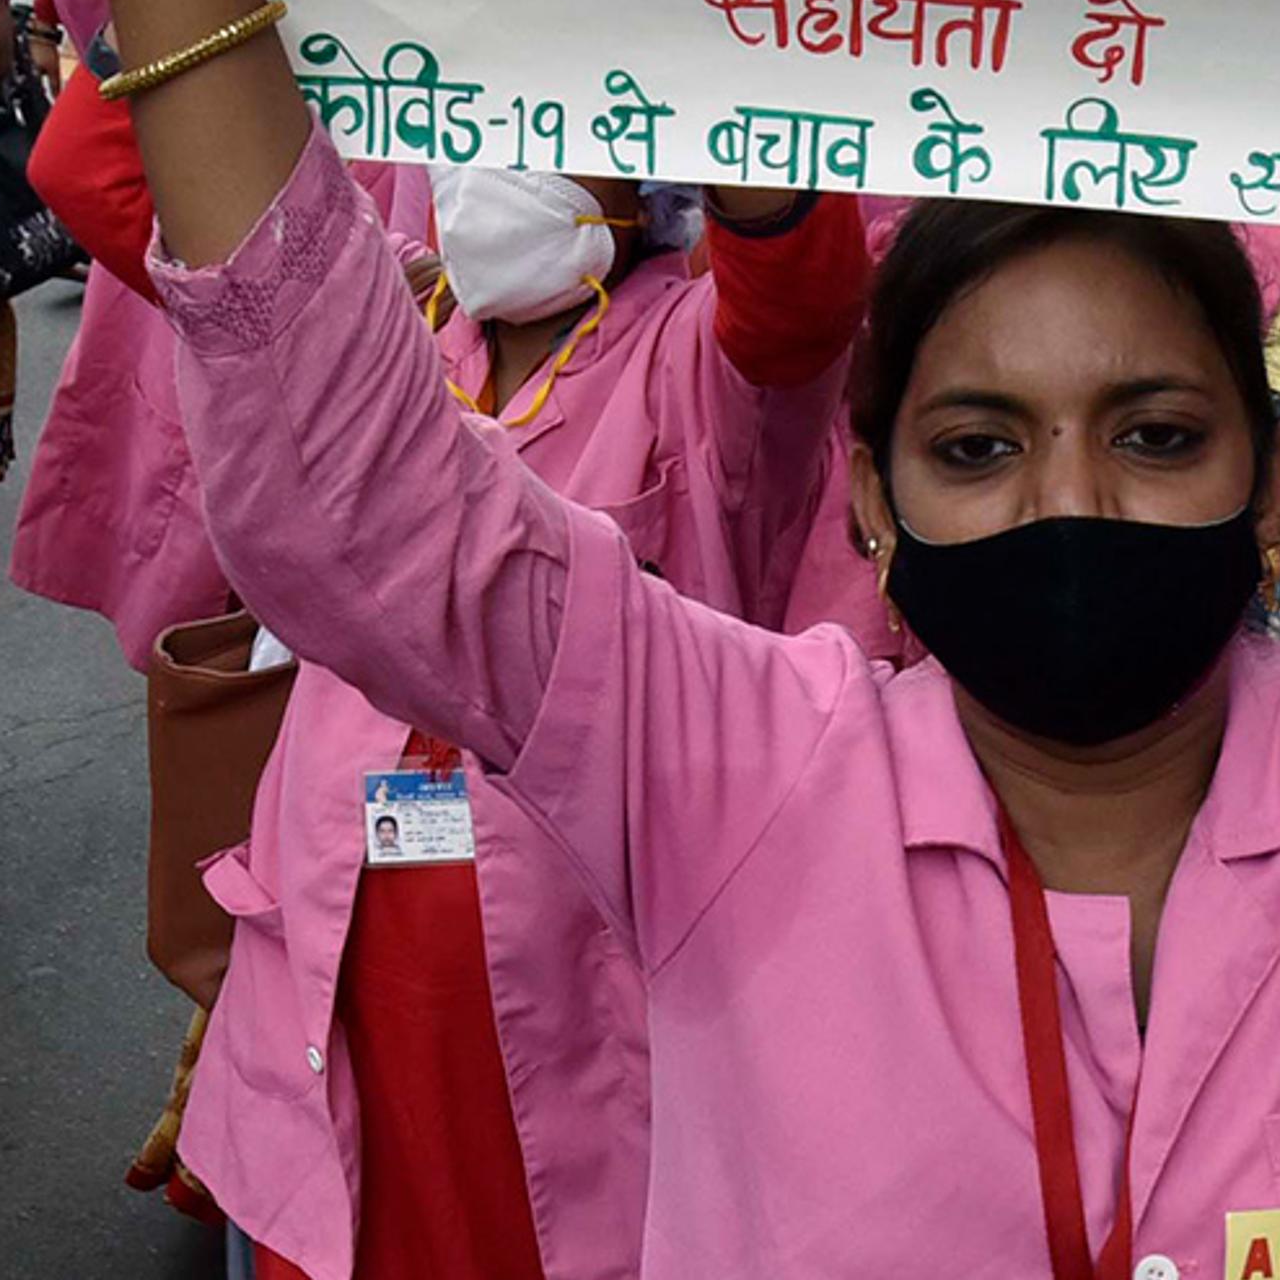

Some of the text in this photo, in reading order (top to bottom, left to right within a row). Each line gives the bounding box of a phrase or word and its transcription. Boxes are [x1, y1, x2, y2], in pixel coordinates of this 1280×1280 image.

[591, 69, 676, 175] से
[707, 105, 875, 191] बचाव
[910, 87, 992, 195] के
[1040, 97, 1198, 207] लिए
